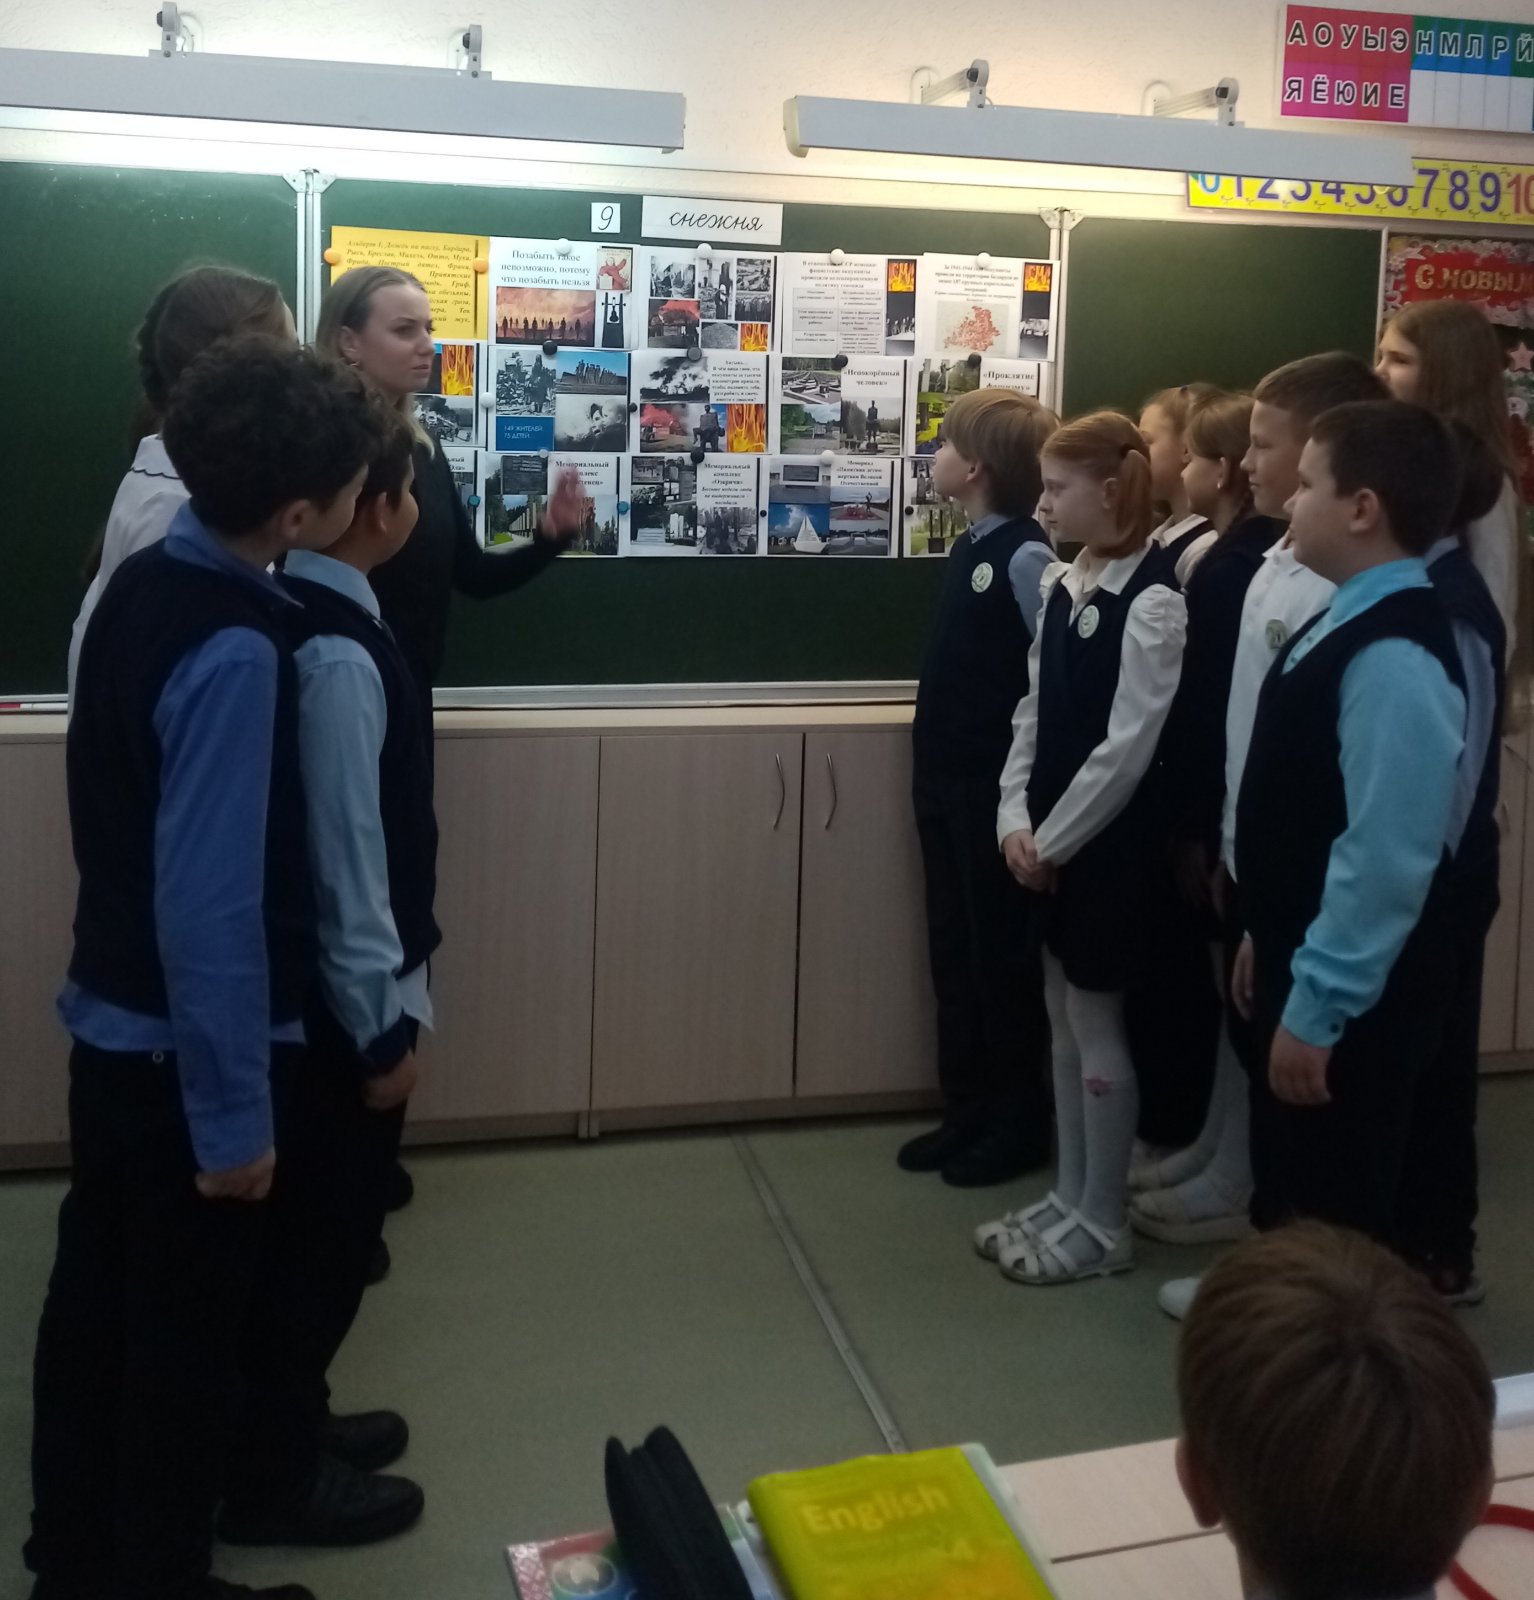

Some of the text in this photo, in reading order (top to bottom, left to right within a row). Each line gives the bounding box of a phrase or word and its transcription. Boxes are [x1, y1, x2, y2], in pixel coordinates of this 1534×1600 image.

[1417, 168, 1440, 208] 7
[1449, 170, 1470, 210] 8
[1479, 172, 1501, 212] 9
[598, 206, 763, 232] 9 снежня
[512, 250, 554, 260] Позабыть
[502, 264, 590, 276] невозможно, потому
[518, 276, 560, 285] позабыть
[844, 368, 900, 378] «Непокорённый
[983, 371, 1034, 380] «Проклятие
[801, 1484, 949, 1534] English
